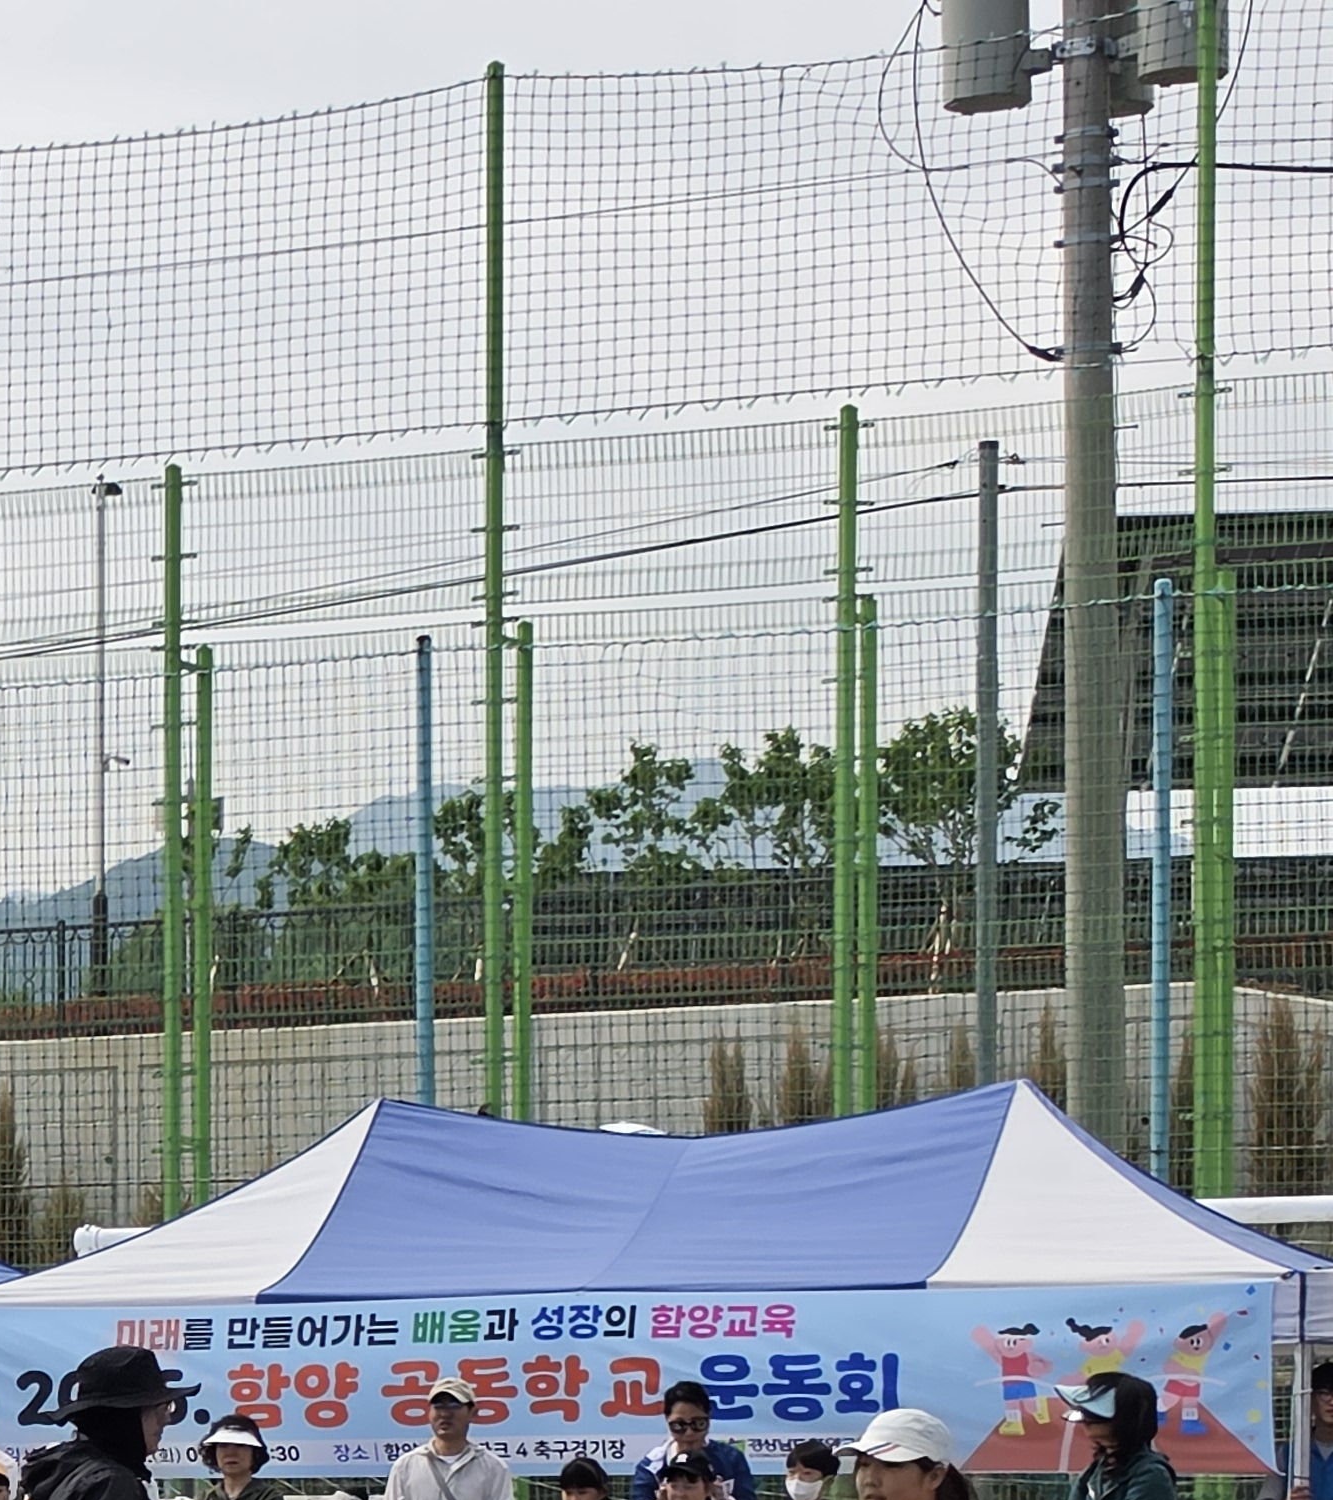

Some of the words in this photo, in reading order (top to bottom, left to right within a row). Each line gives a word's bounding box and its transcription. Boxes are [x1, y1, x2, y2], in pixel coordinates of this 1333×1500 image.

[116, 1317, 214, 1351] 미래를
[227, 1313, 400, 1350] 만들어가는
[411, 1307, 520, 1344] 배움과
[531, 1304, 638, 1340] 성장의
[650, 1303, 797, 1339] 함양교육
[227, 1362, 360, 1429] 함양
[380, 1354, 666, 1426] 공동학교
[699, 1351, 900, 1422] 운동회
[333, 1444, 370, 1463] 장소
[516, 1442, 527, 1458] 4
[534, 1438, 626, 1459] 축구경기장
